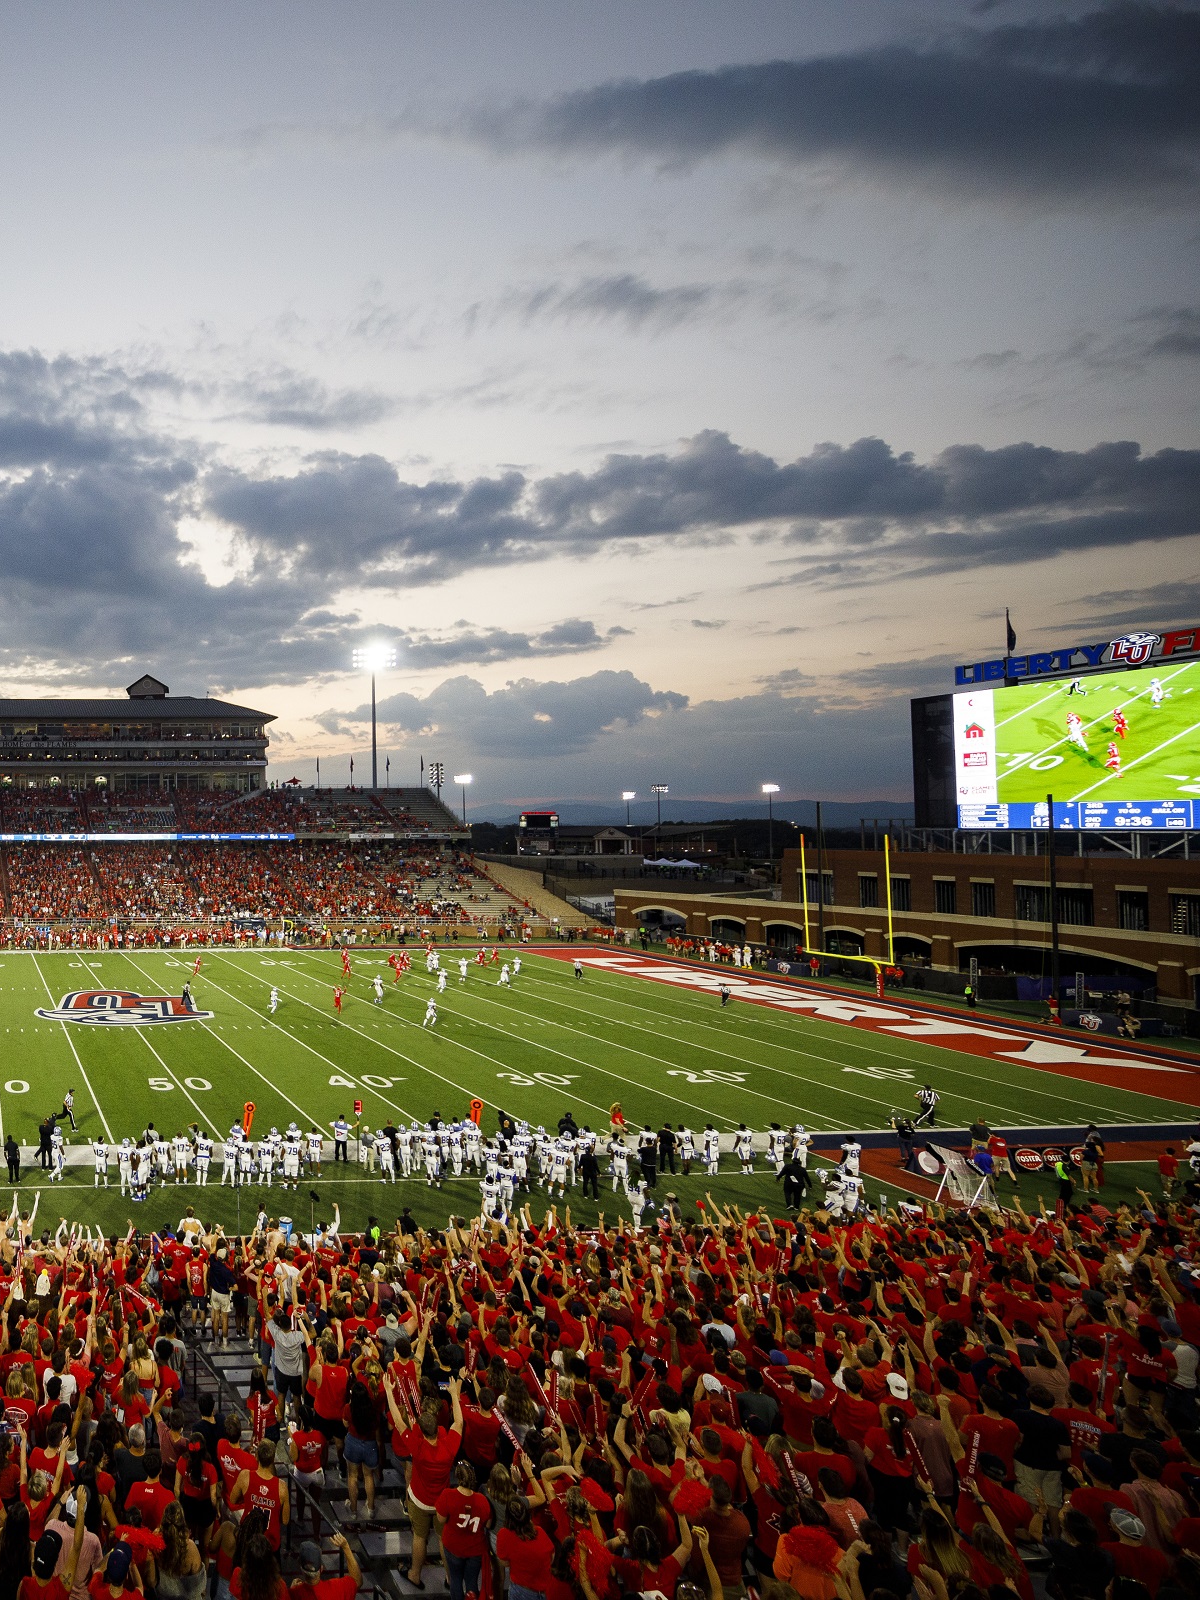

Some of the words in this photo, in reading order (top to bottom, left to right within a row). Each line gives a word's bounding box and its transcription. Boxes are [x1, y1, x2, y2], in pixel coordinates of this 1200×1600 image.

[954, 642, 1108, 686] LIBERTY
[1114, 816, 1153, 827] 9:36
[583, 955, 1198, 1073] LIBERTY
[496, 1072, 572, 1086] 30
[666, 1069, 746, 1083] 20
[841, 1066, 916, 1080] 10
[148, 1076, 213, 1091] 50
[328, 1074, 394, 1089] 40
[1017, 1154, 1042, 1162] FOSTER
[1043, 1153, 1063, 1162] FOSTE
[250, 1493, 276, 1508] FLAMES
